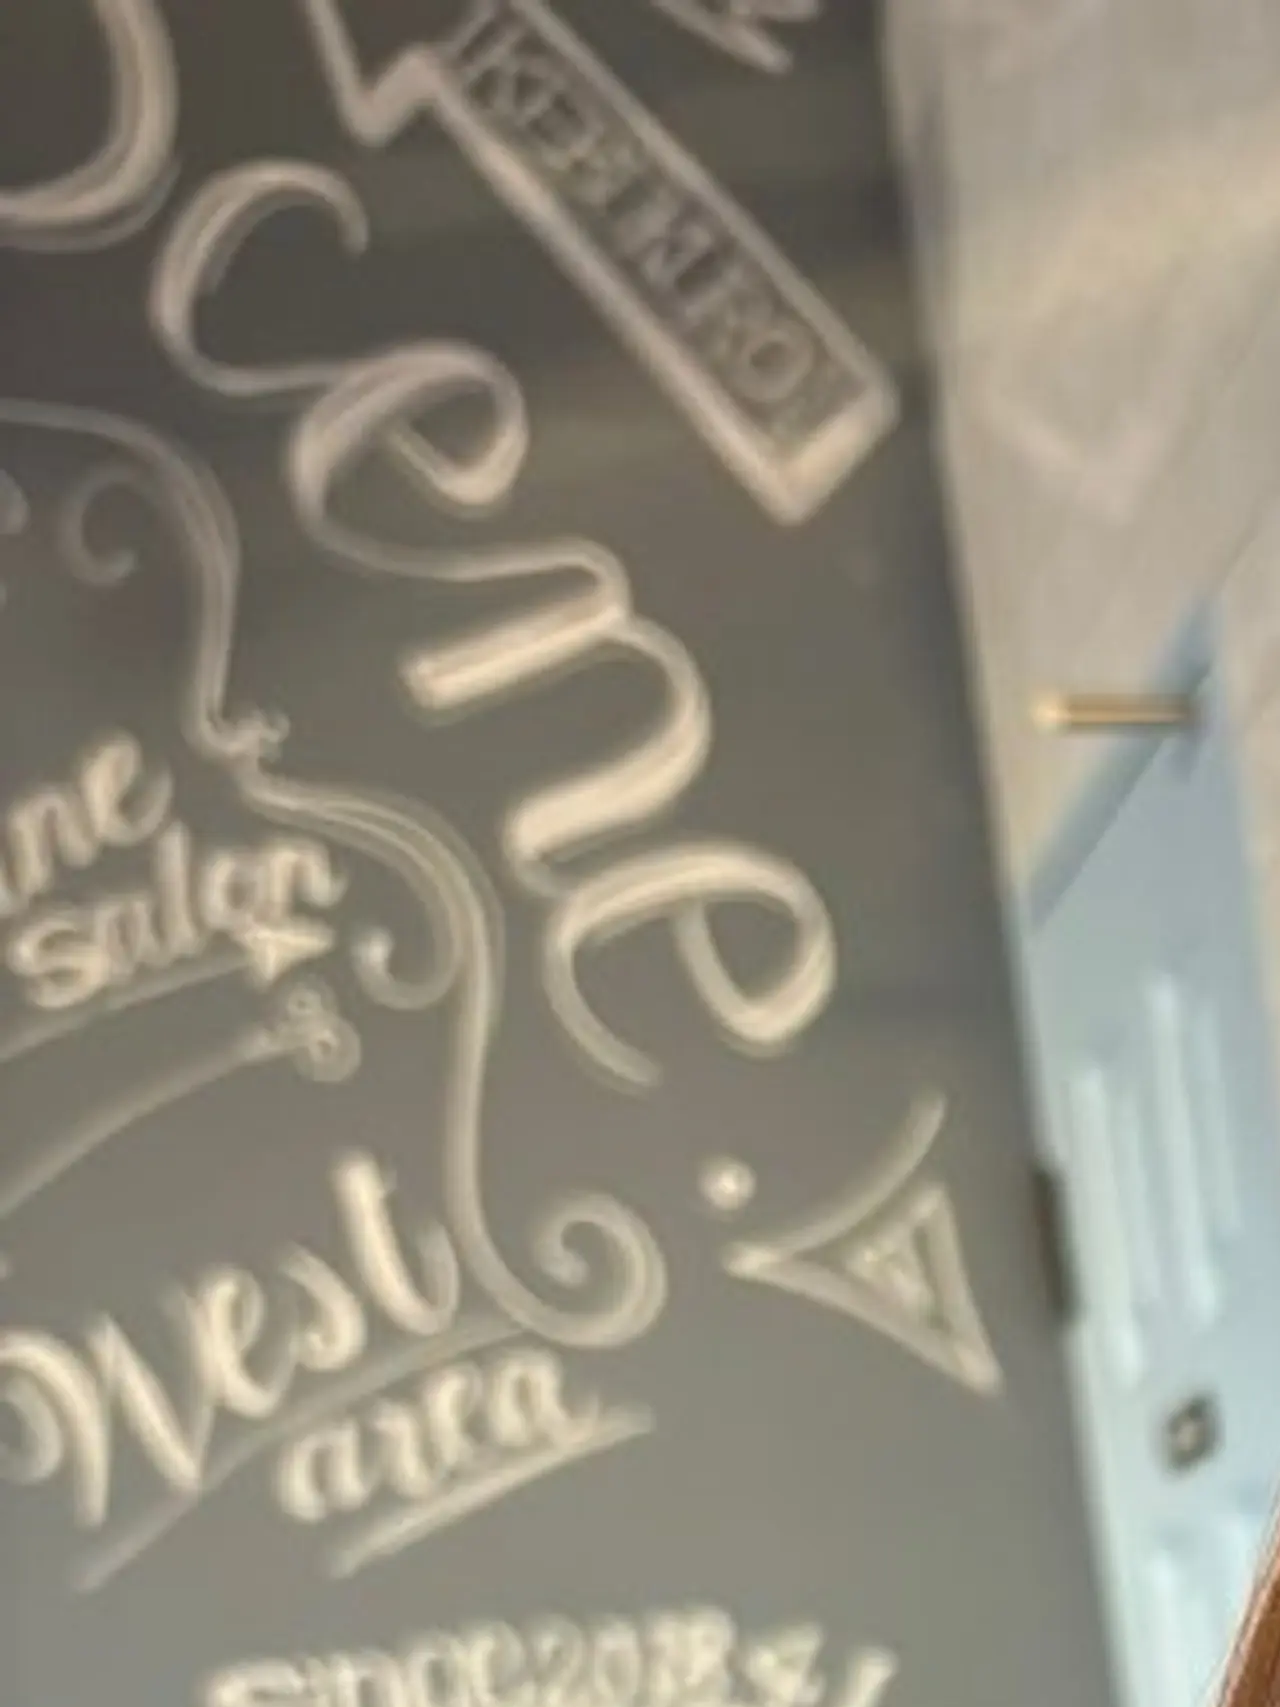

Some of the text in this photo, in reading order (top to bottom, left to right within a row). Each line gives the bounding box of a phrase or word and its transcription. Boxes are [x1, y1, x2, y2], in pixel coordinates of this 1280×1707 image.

[5, 820, 347, 1012] salon
[0, 1146, 462, 1527] West
[275, 1346, 602, 1525] area
